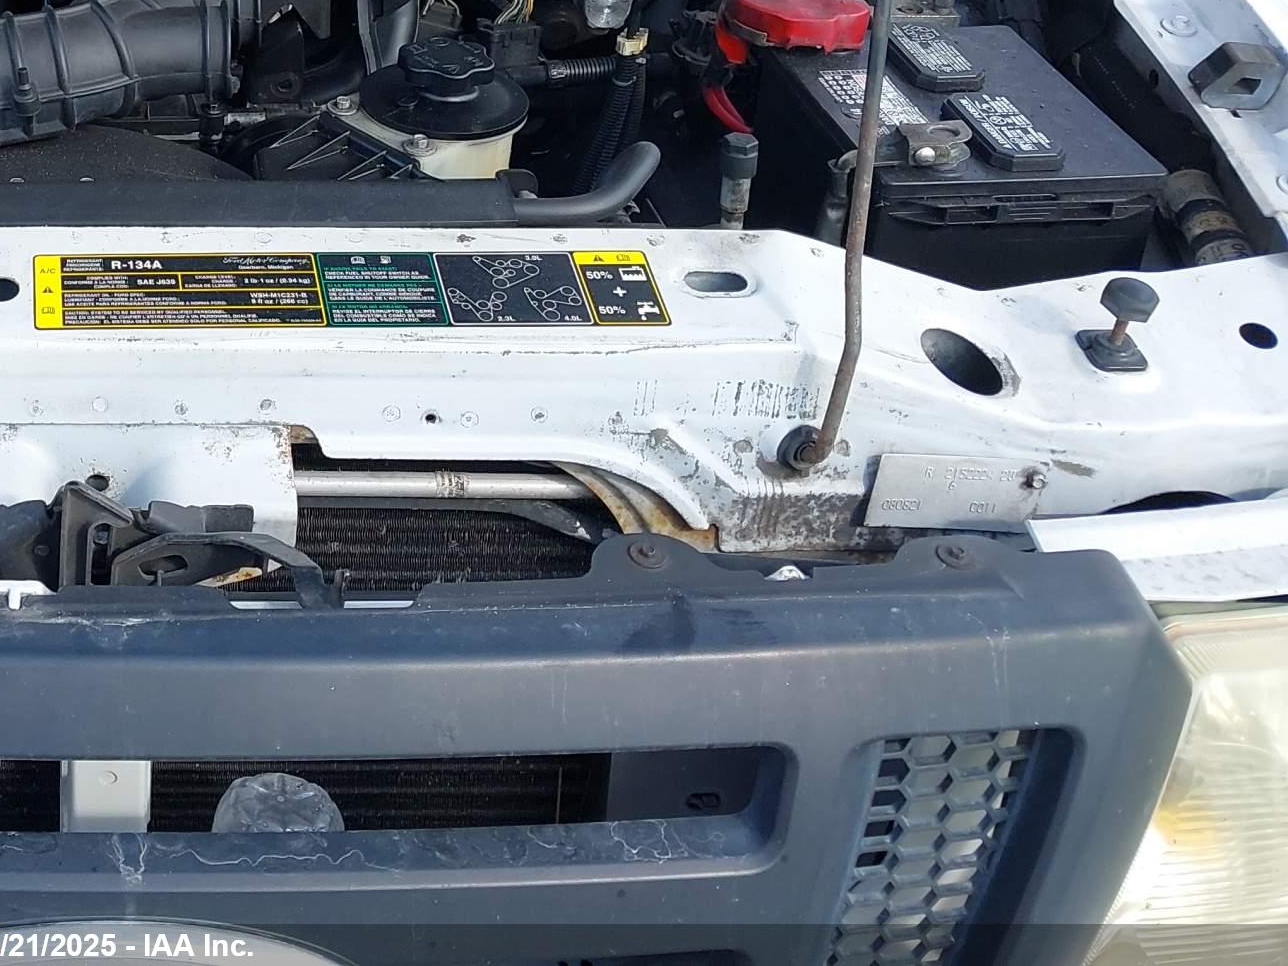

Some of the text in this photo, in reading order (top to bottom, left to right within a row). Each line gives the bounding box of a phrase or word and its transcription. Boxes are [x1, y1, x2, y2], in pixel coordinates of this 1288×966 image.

[111, 260, 163, 270] R-134A
[586, 271, 613, 280] 50%
[599, 306, 626, 315] 50%
